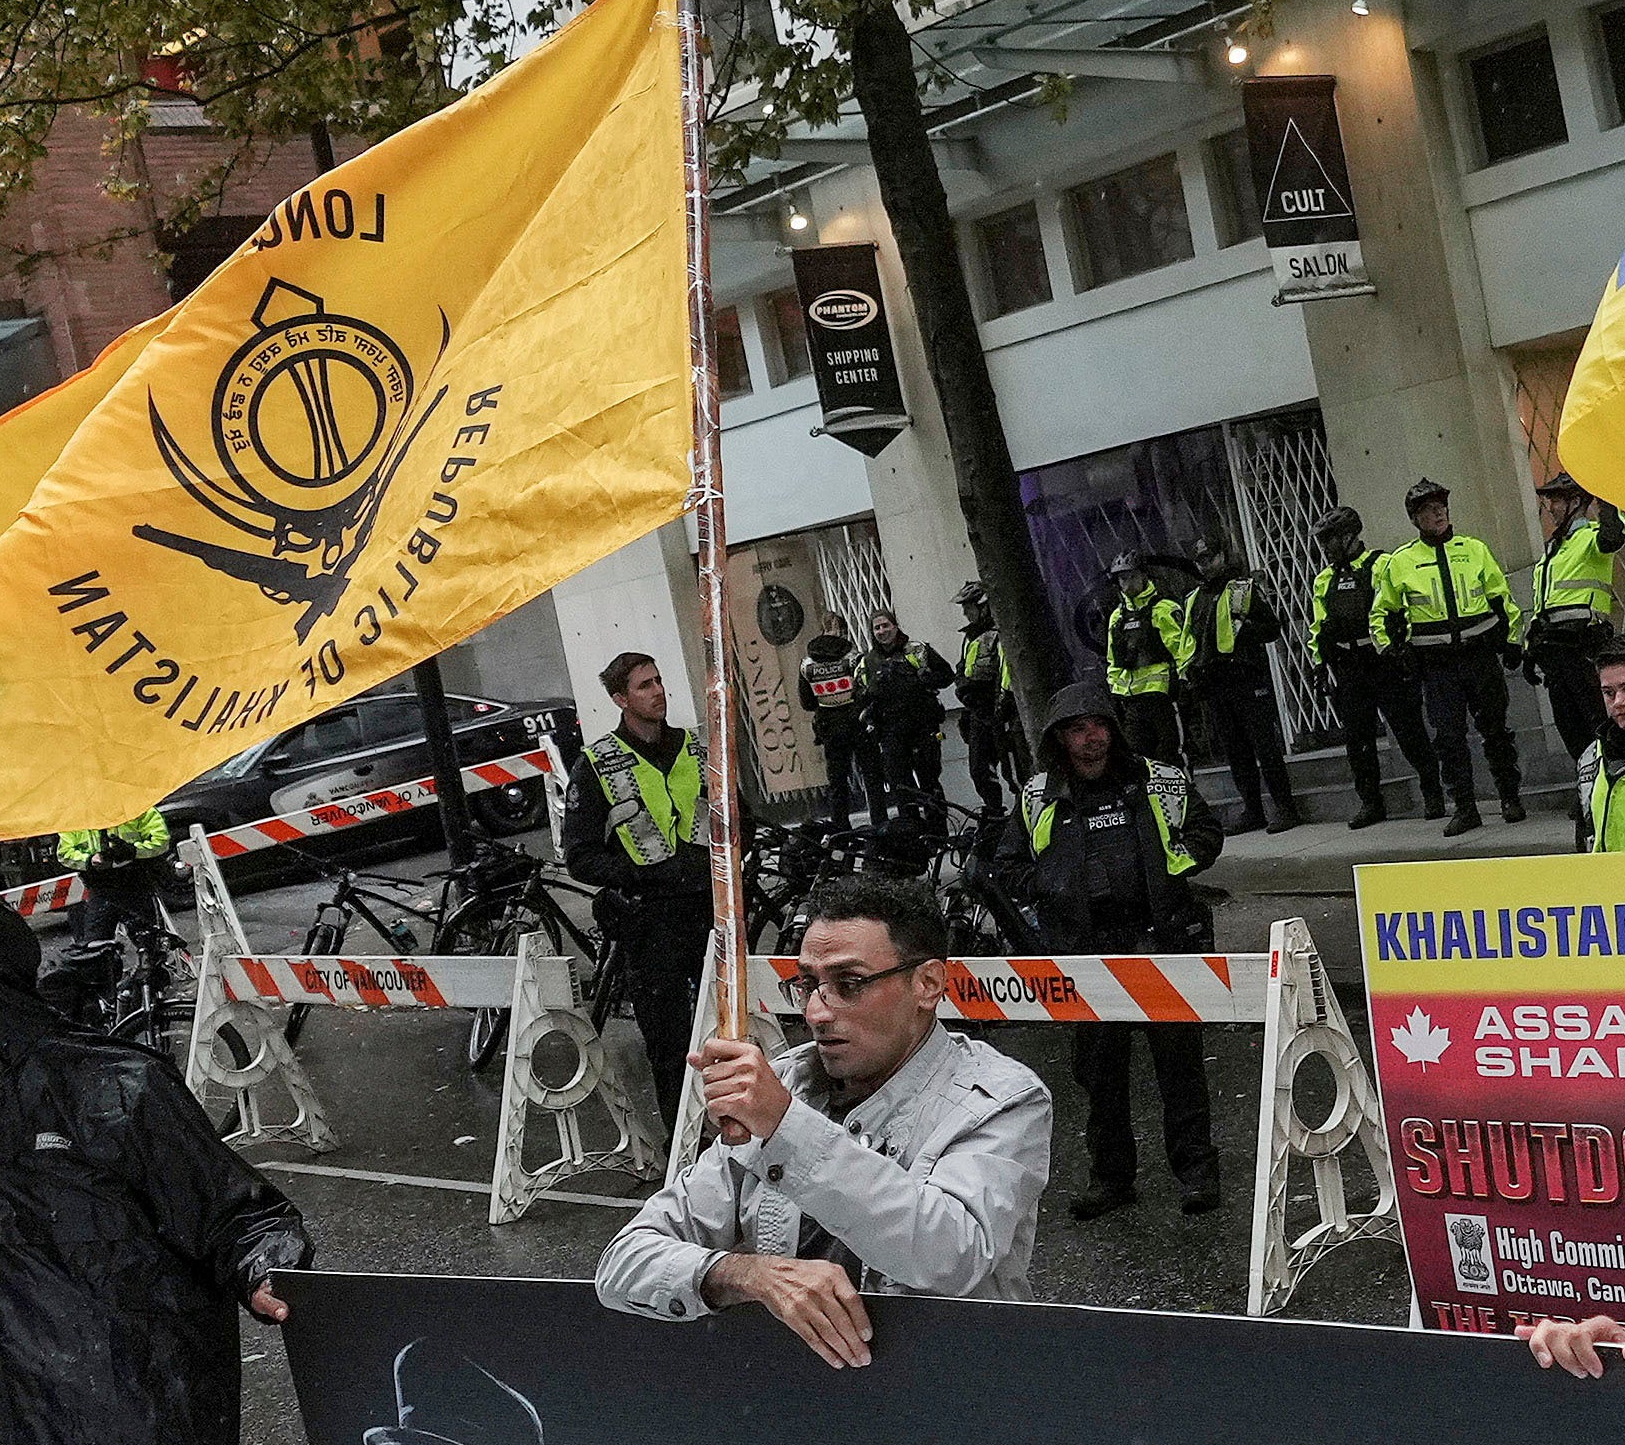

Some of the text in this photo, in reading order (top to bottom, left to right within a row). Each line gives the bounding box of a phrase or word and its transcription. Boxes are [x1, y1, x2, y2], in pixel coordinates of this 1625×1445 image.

[1280, 188, 1325, 213] CULT
[1289, 253, 1349, 279] SALON
[816, 303, 868, 315] PHANTOM
[826, 348, 880, 366] SHIPPING
[835, 367, 878, 385] CENTER
[812, 664, 843, 675] POLICE
[523, 712, 556, 734] 911
[395, 788, 413, 807] OF
[1146, 783, 1187, 795] POLICE
[310, 792, 389, 826] VANCOUVER
[1089, 815, 1126, 830] POLICE
[305, 966, 425, 992] CITY OF VANCOUVER
[953, 976, 1078, 1003] VANCOUVER
[1495, 1225, 1545, 1269] High
[1502, 1268, 1582, 1303] Ottawa,
